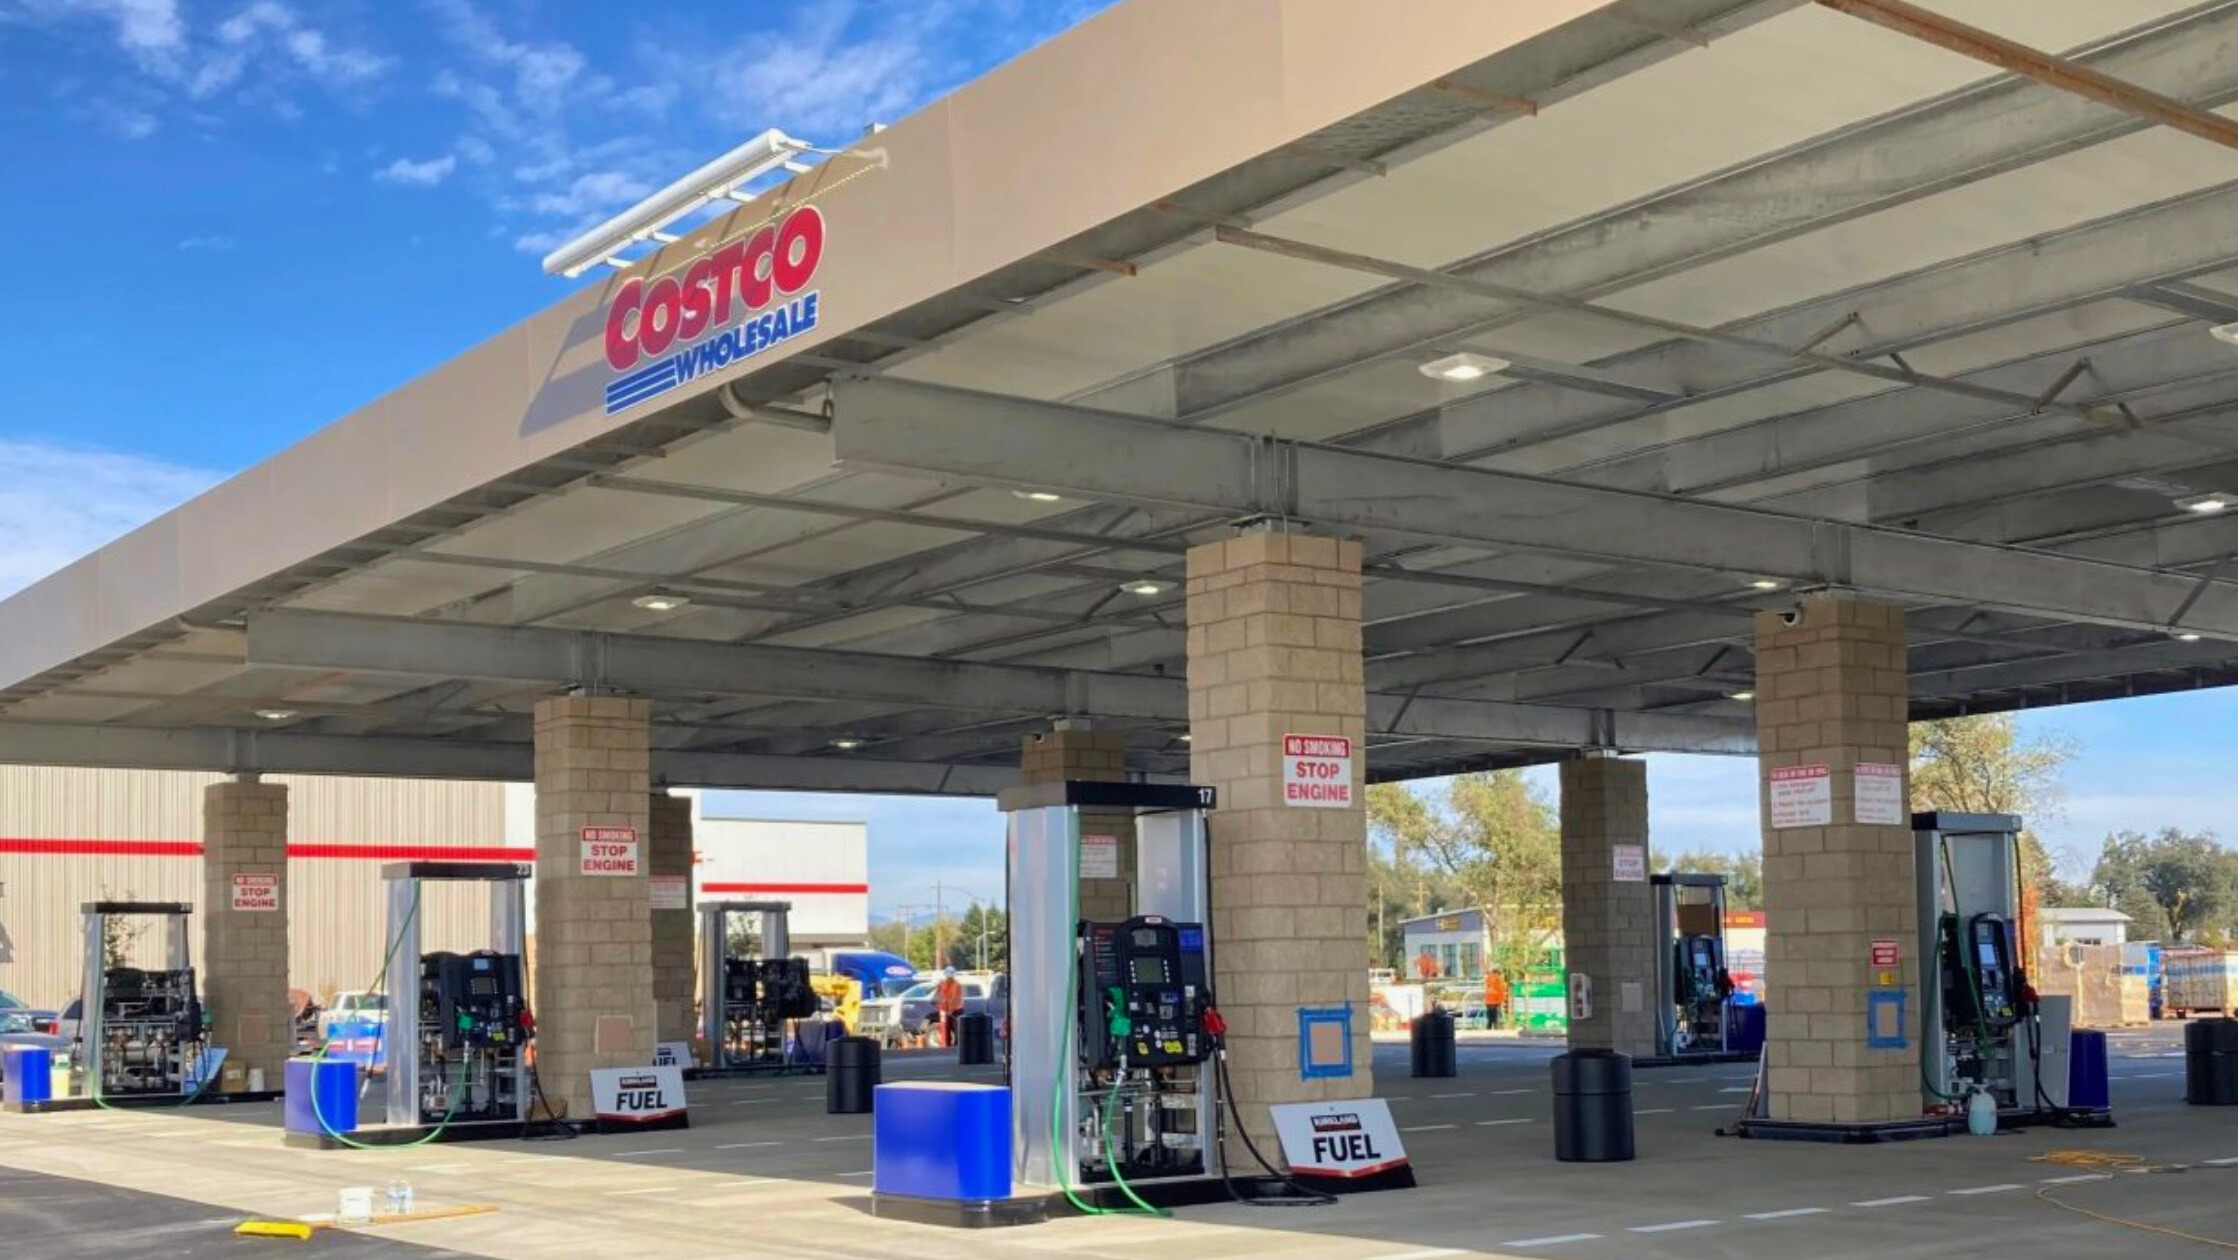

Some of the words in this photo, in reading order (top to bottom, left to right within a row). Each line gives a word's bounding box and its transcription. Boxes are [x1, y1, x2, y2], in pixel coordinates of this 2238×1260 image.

[604, 204, 826, 371] COSTCO
[673, 290, 820, 386] WHOLESALE
[1287, 738, 1302, 755] NO
[1303, 738, 1347, 757] SMOKING
[1296, 761, 1340, 779] STOP
[1198, 787, 1212, 804] 17
[1287, 783, 1349, 802] ENGINE
[591, 844, 628, 857] STOP
[583, 860, 635, 872] ENGINE
[240, 887, 270, 896] STOP
[234, 898, 276, 907] ENGINE
[615, 1090, 668, 1111] FUEL
[1312, 1114, 1359, 1127] KIRKLAND
[1312, 1133, 1382, 1164] FUEL
